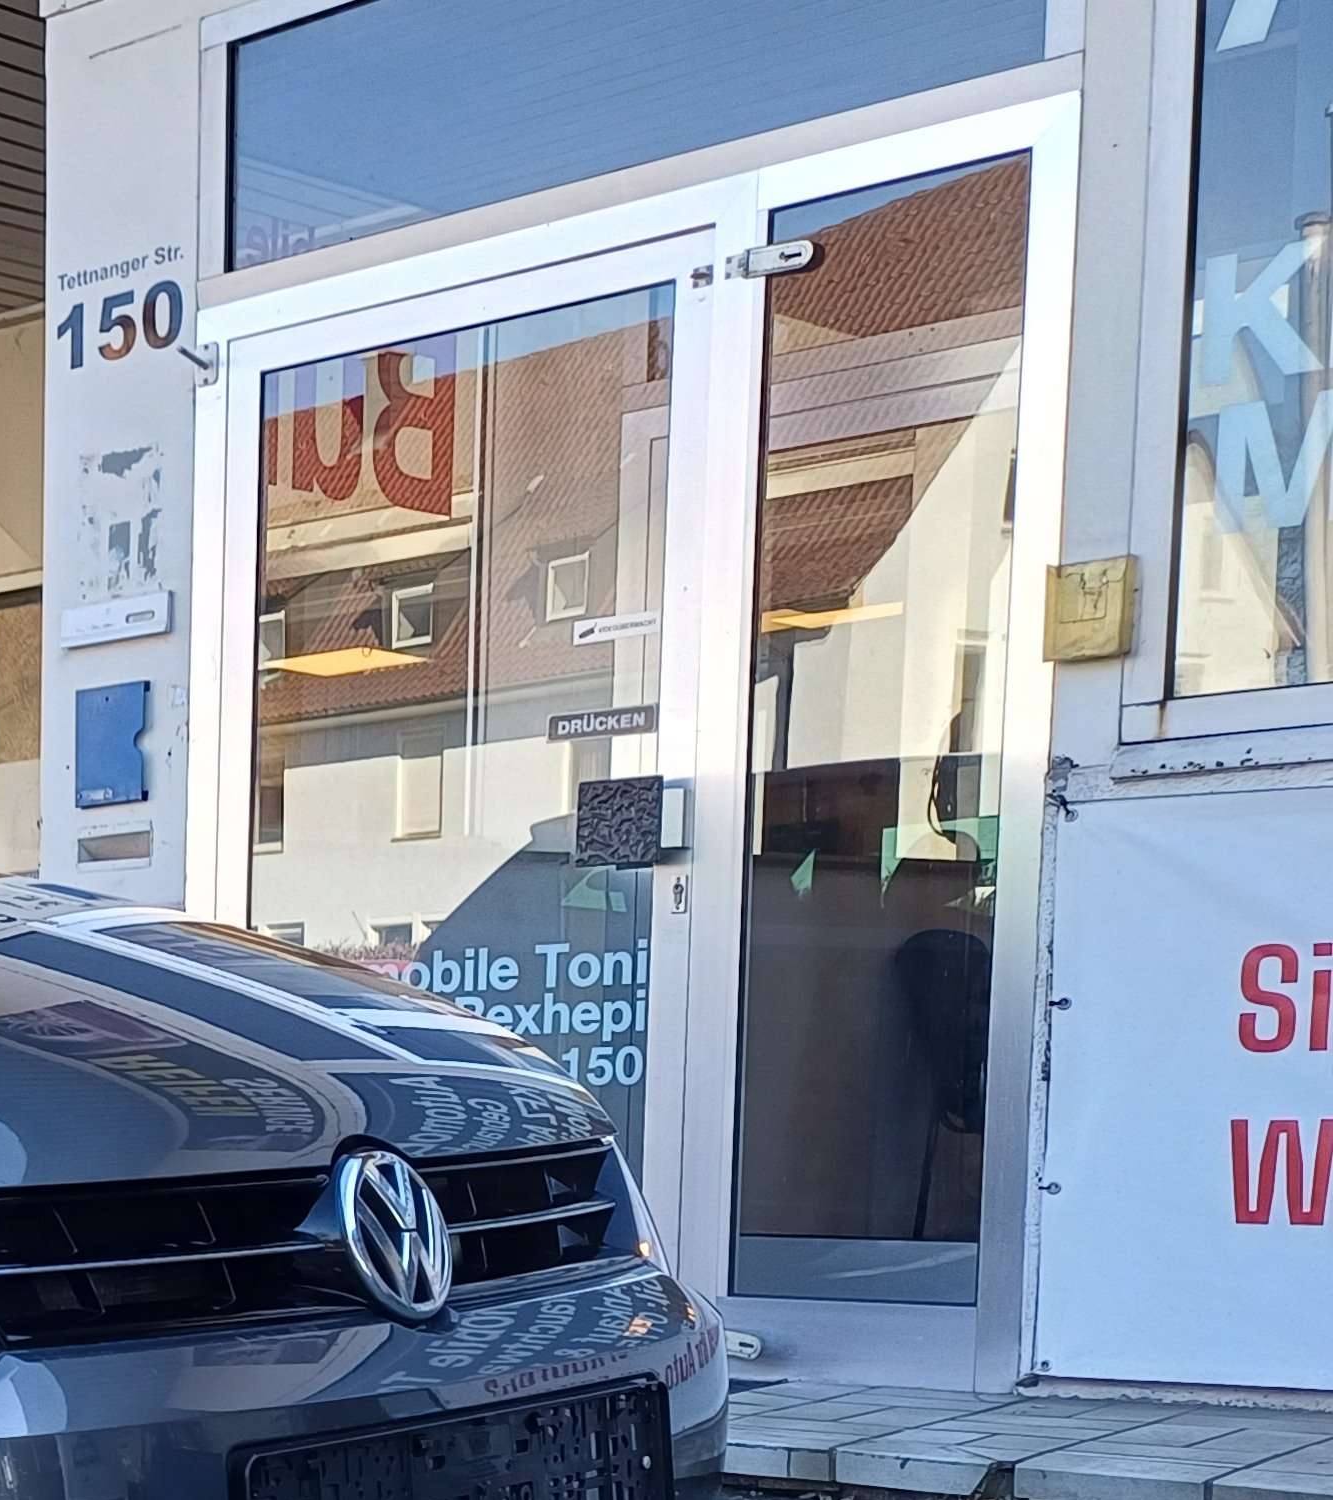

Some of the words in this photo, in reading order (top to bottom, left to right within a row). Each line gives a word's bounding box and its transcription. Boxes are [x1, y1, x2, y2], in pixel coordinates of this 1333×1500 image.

[57, 254, 150, 292] Tettnanger
[154, 245, 184, 265] Str.
[56, 280, 183, 370] 150
[556, 711, 646, 736] DRÜCKEN
[534, 938, 649, 989] Toni
[1238, 943, 1333, 1053] Si
[561, 1045, 644, 1086] 150
[1230, 1119, 1333, 1226] W
